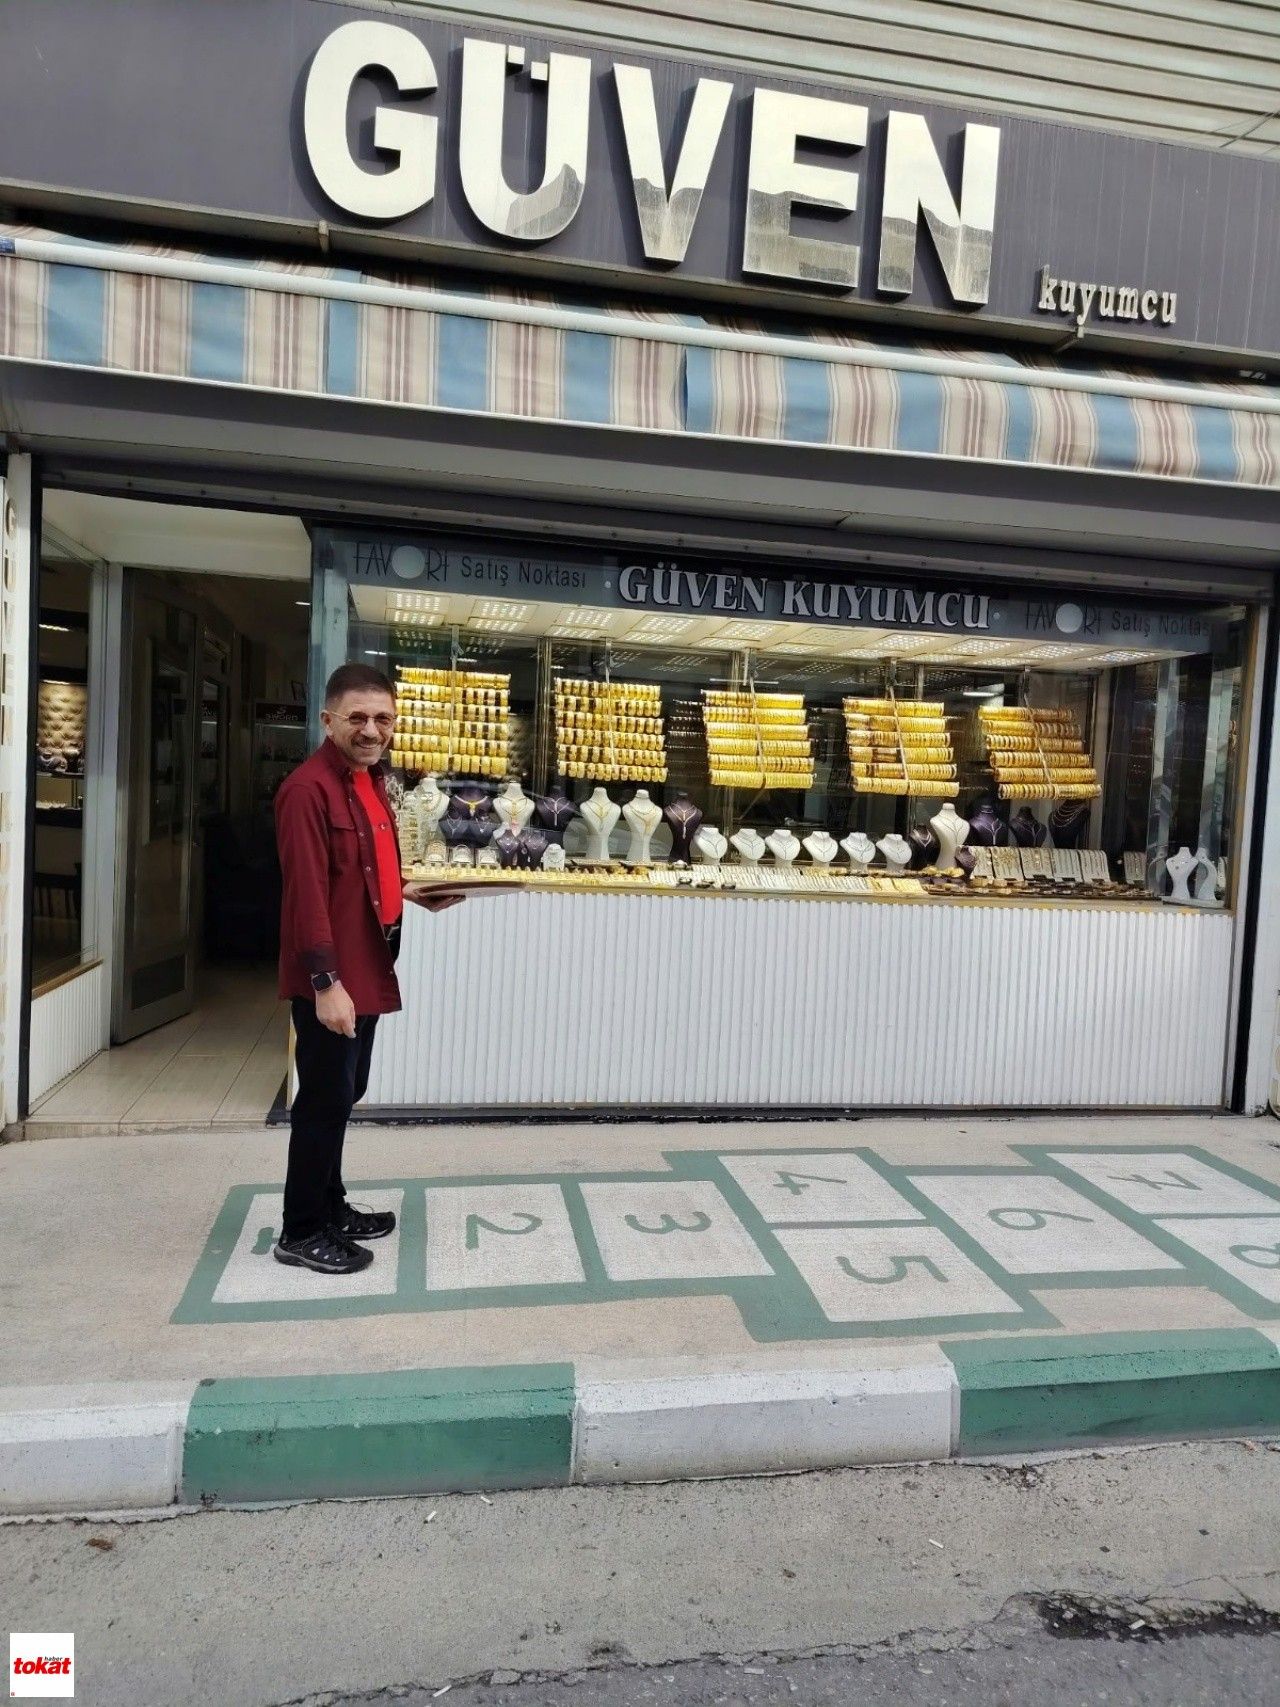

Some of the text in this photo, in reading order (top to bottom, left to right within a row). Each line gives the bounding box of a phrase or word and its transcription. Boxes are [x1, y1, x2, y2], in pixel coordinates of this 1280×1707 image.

[304, 20, 1001, 305] GÜVEN
[1038, 264, 1178, 326] kuyumcu
[461, 555, 509, 586] Satış
[518, 562, 587, 589] Noktası
[619, 561, 992, 629] GÜVEN KUYUMCU
[771, 1170, 848, 1196] 4
[464, 1212, 543, 1251] 2
[623, 1210, 712, 1235] 3
[987, 1206, 1095, 1231] 6
[836, 1254, 950, 1285] 5
